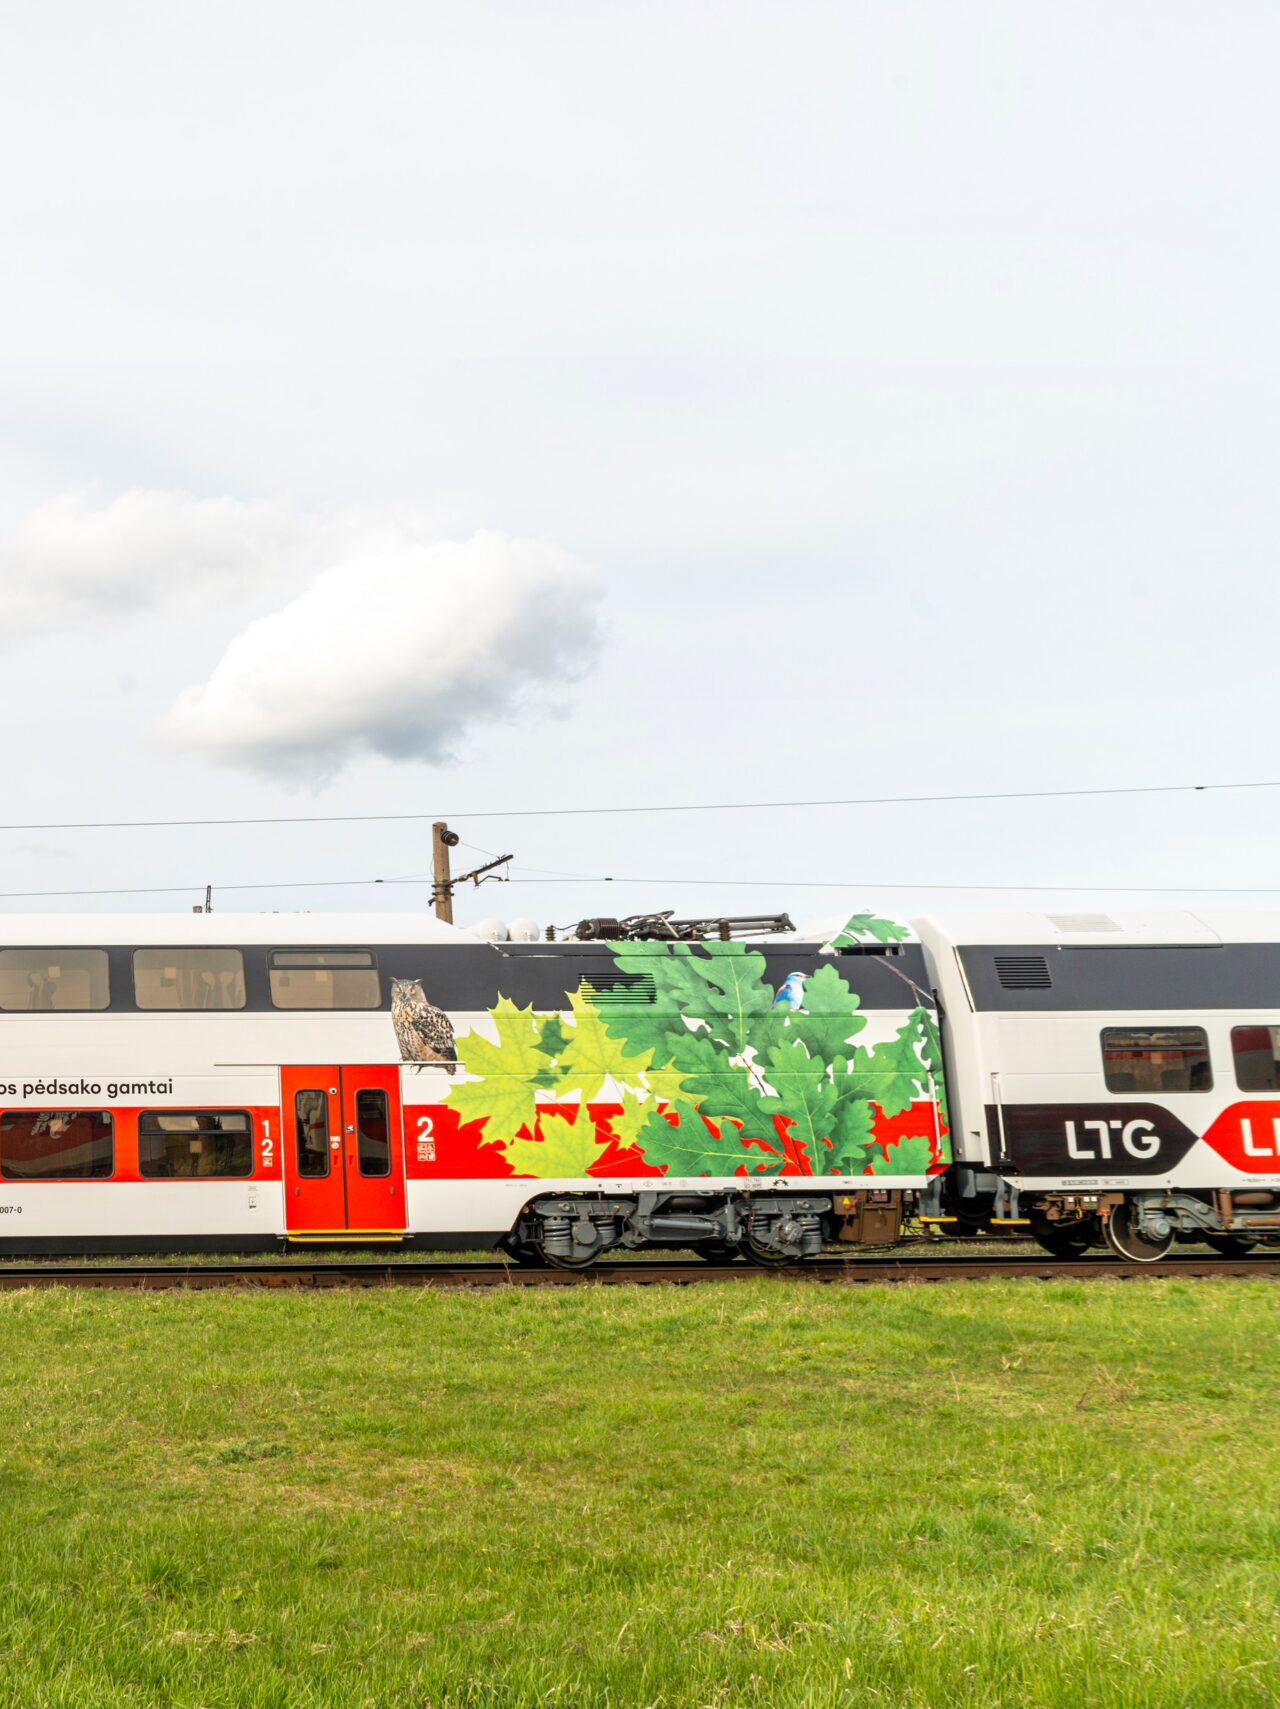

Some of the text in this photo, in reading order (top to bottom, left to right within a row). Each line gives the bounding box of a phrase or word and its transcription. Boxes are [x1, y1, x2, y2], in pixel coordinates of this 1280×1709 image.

[23, 1078, 102, 1099] pėdsako
[107, 1078, 173, 1099] gamtai
[262, 1119, 270, 1138] 1
[416, 1116, 434, 1142] 2
[261, 1138, 273, 1157] 2
[1065, 1120, 1161, 1160] LTG
[0, 1206, 23, 1214] 007-0
